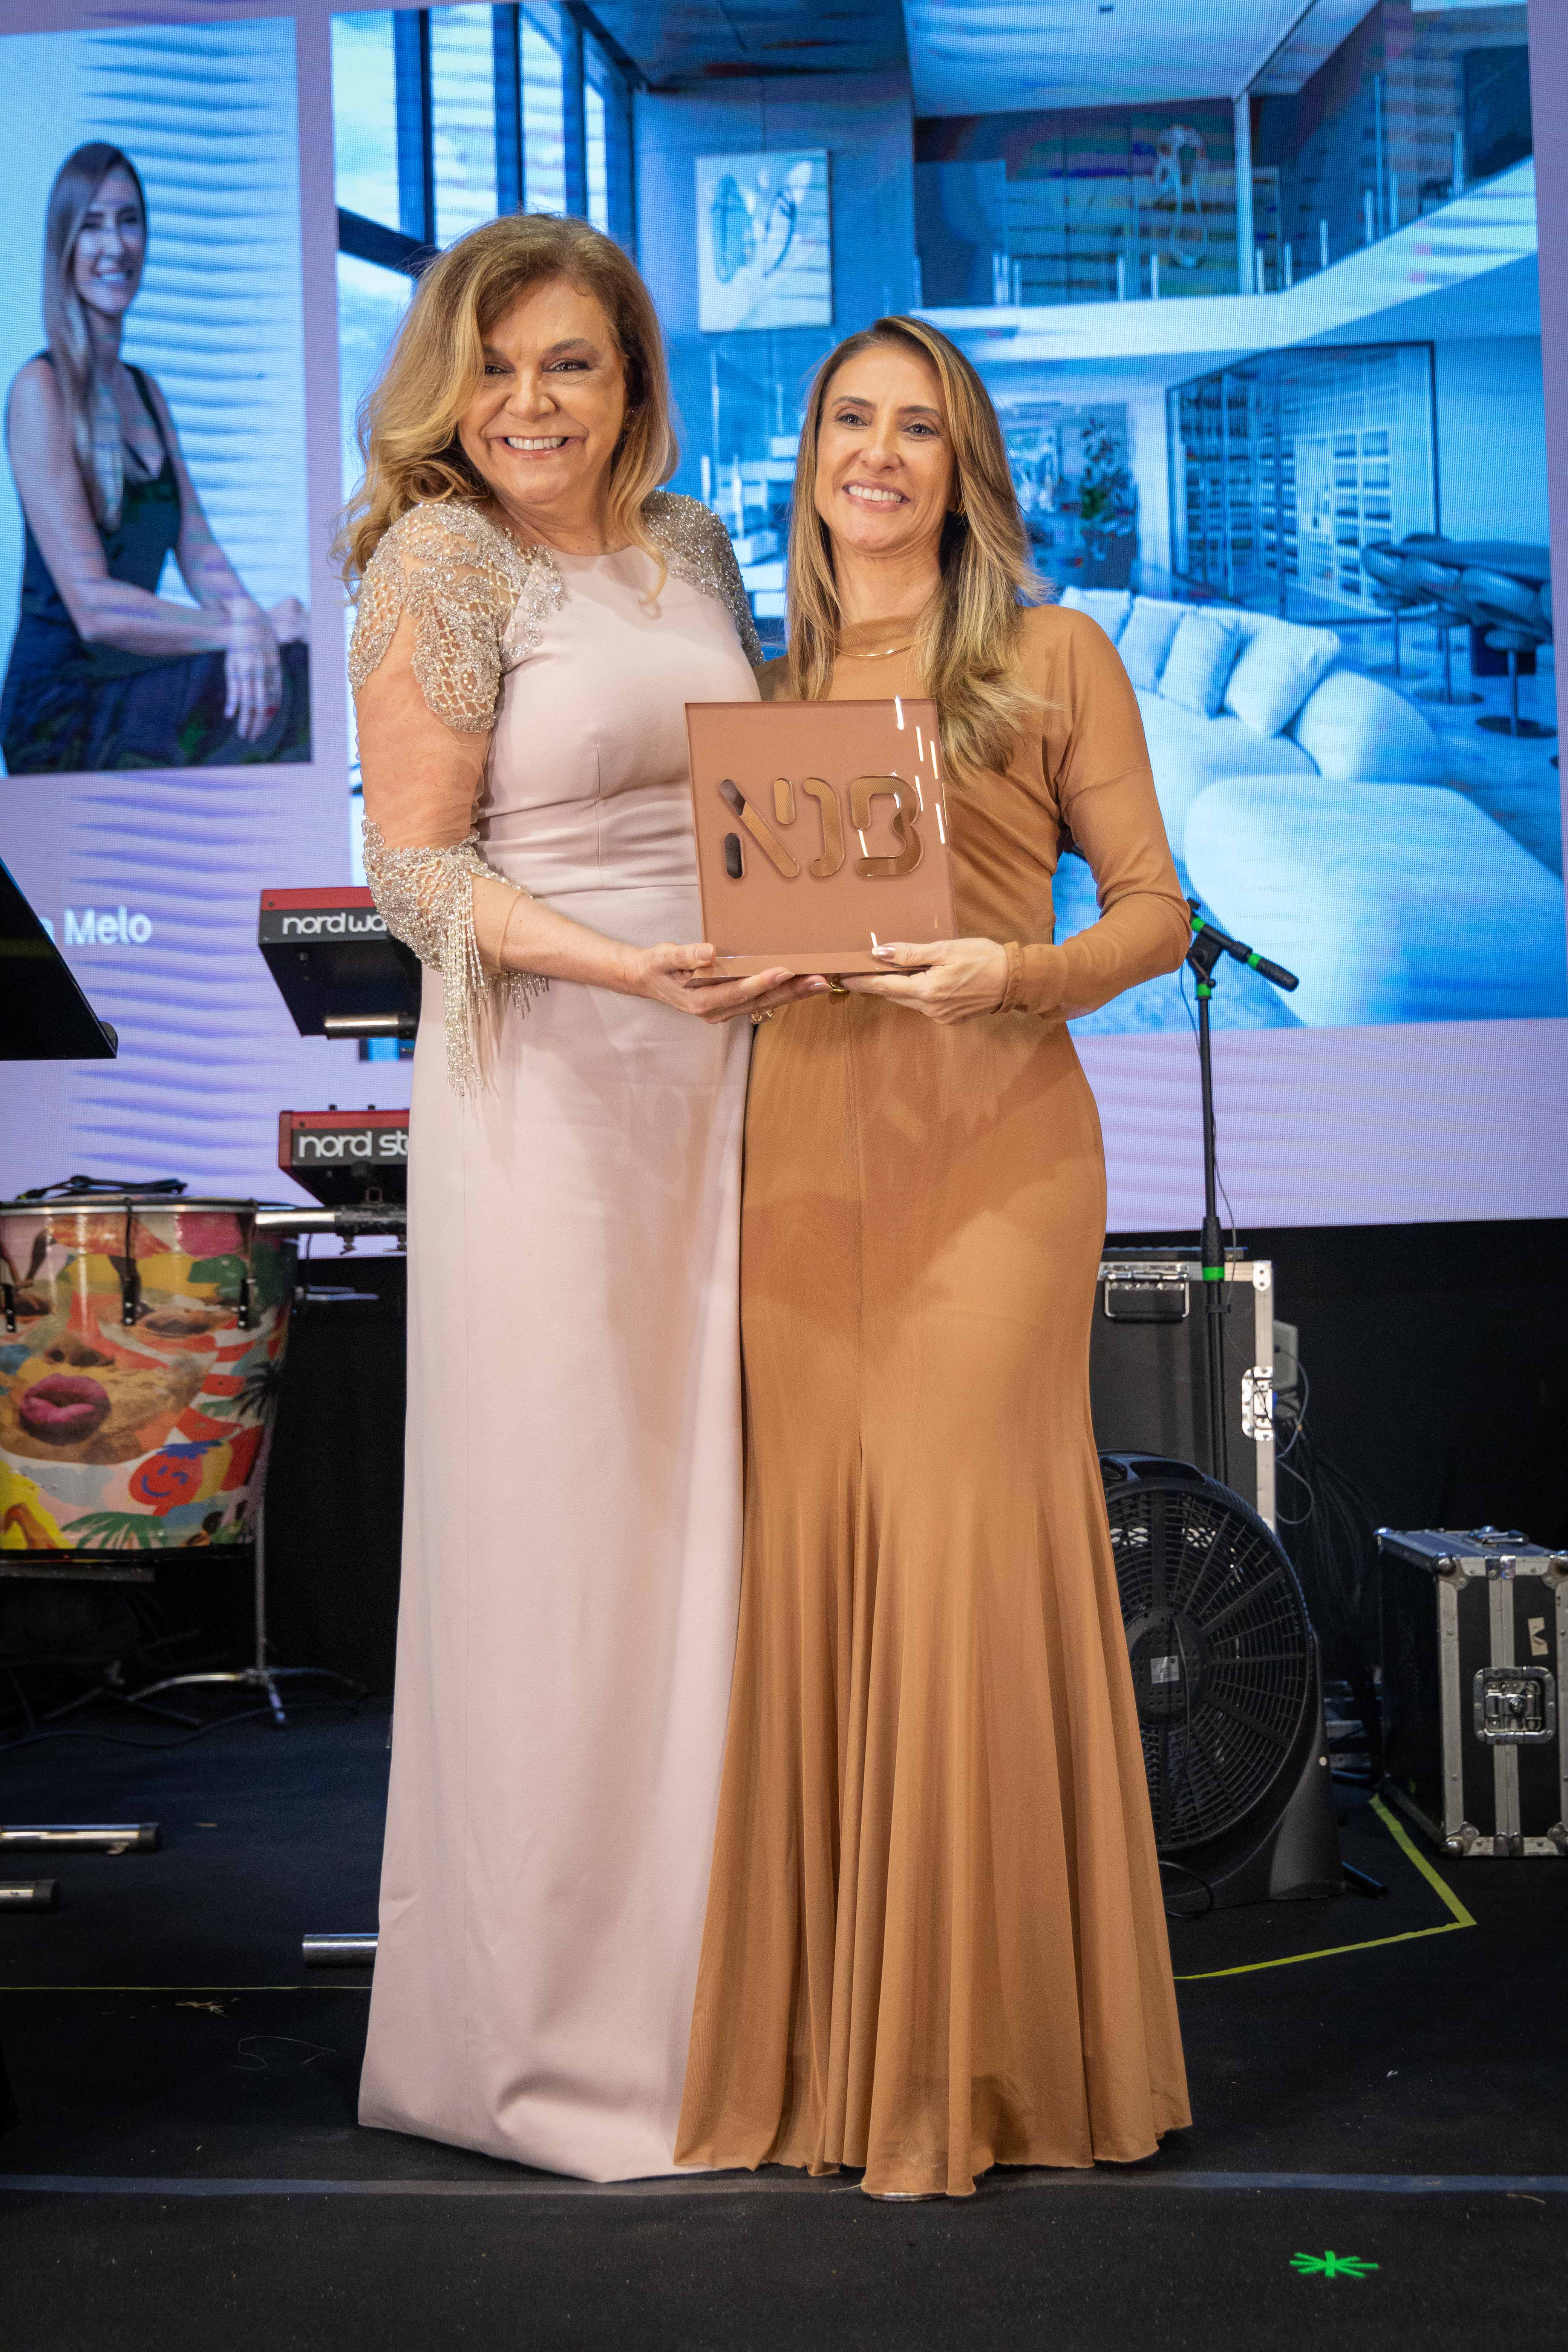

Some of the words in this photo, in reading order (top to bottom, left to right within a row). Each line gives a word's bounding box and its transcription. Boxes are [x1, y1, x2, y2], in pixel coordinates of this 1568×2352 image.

[64, 905, 152, 946] Melo
[282, 912, 346, 935] nord
[299, 1131, 372, 1158] nord
